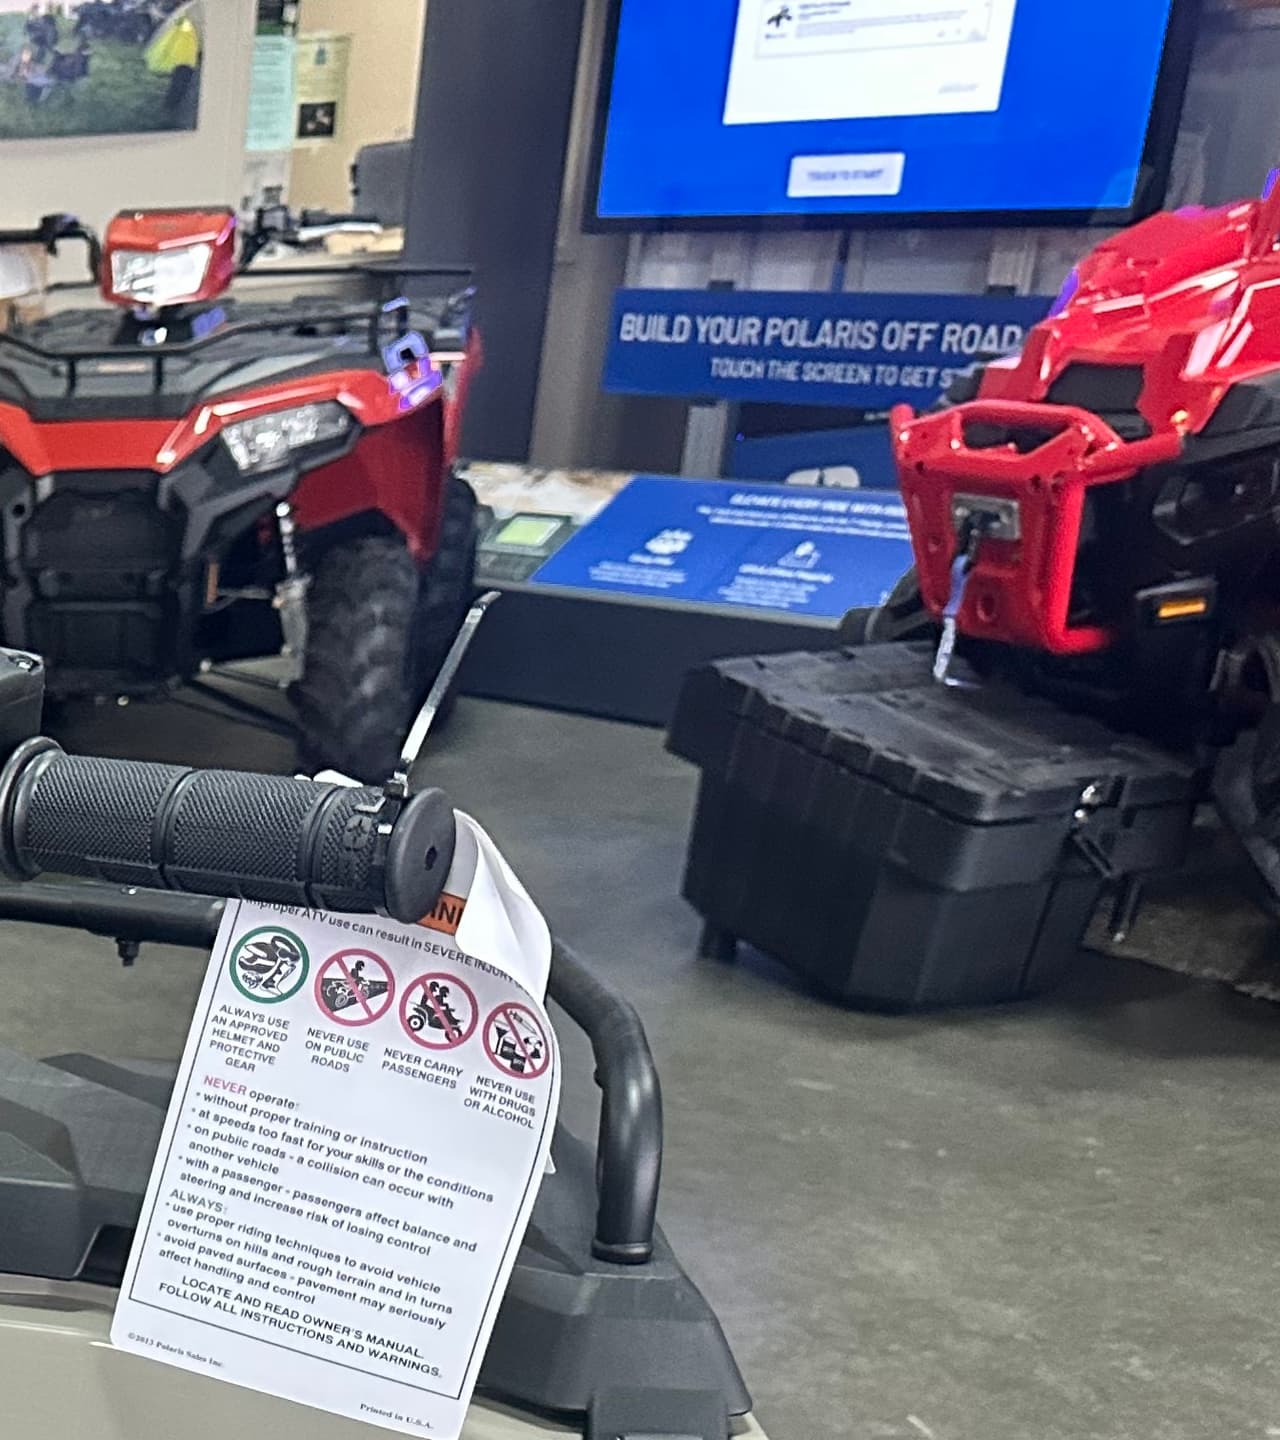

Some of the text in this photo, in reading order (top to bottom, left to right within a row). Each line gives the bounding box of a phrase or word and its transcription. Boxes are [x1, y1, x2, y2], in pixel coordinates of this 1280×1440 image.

[620, 313, 1022, 355] BUILD YOUR POLARIS OFF ROAD
[711, 357, 937, 387] TOUCH THE SCREEN TO GET
[300, 909, 329, 924] ATV
[328, 917, 351, 931] use
[352, 923, 374, 937] can
[375, 927, 411, 946] result
[410, 937, 423, 950] in
[423, 941, 473, 967] SEVERE
[210, 1014, 288, 1042] AN APPROVED
[218, 1003, 290, 1030] ALWAYS USE
[208, 1039, 276, 1066] PROTECTIVE
[211, 1026, 280, 1053] HELMET AND
[304, 1039, 364, 1064] ON PUBLIC
[306, 1026, 370, 1052] NEVER USE
[224, 1056, 256, 1072] GEAR
[309, 1054, 350, 1073] ROADS
[380, 1059, 456, 1089] PASSENGERS
[383, 1047, 464, 1078] NEVER CARRY
[202, 1074, 247, 1096] NEVER
[475, 1074, 535, 1105] NEVER USE
[463, 1097, 535, 1130] OR ALCOHOL
[469, 1085, 535, 1118] WITH DRUGS
[203, 1092, 427, 1165] without proper training or instruction
[188, 1140, 279, 1175] another vehicle
[193, 1125, 454, 1210] on public roads a collision can occur with
[197, 1109, 493, 1203] at speeds too fast for your skills or the conditions
[171, 1203, 441, 1294] use proper riding techniques to avoid vehicle
[163, 1233, 447, 1331] avoid paved surfaces pavement may seriously
[181, 1274, 232, 1299] LOCATE
[233, 1292, 261, 1308] AND
[263, 1301, 299, 1320] READ
[301, 1313, 363, 1340] OWNER'S
[158, 1281, 442, 1378] FOLLOW ALL INSTRUCTIONS AND WARNINGS.
[359, 1402, 393, 1418] Printed
